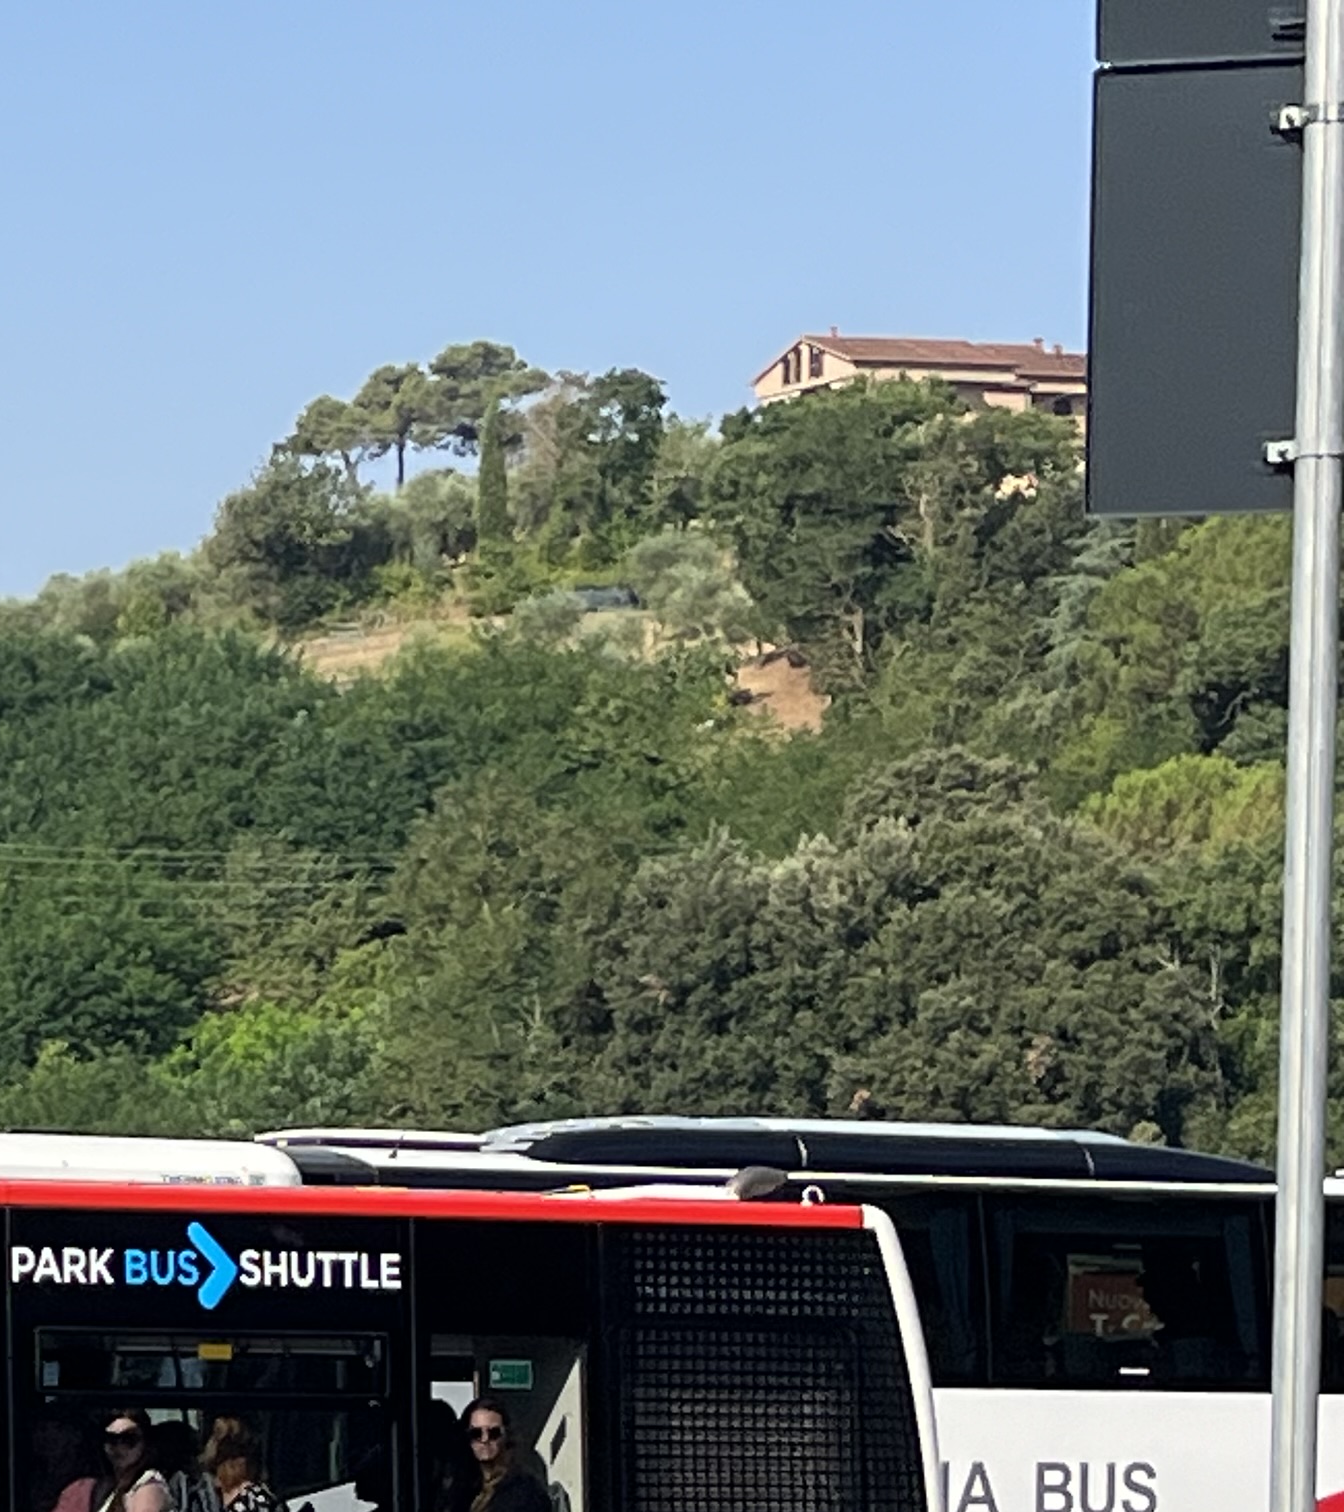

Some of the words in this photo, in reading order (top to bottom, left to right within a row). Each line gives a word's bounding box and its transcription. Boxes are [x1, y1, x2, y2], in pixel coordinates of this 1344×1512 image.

[11, 1246, 115, 1285] PARK
[123, 1248, 201, 1286] BUS
[238, 1249, 403, 1290] SHUTTLE
